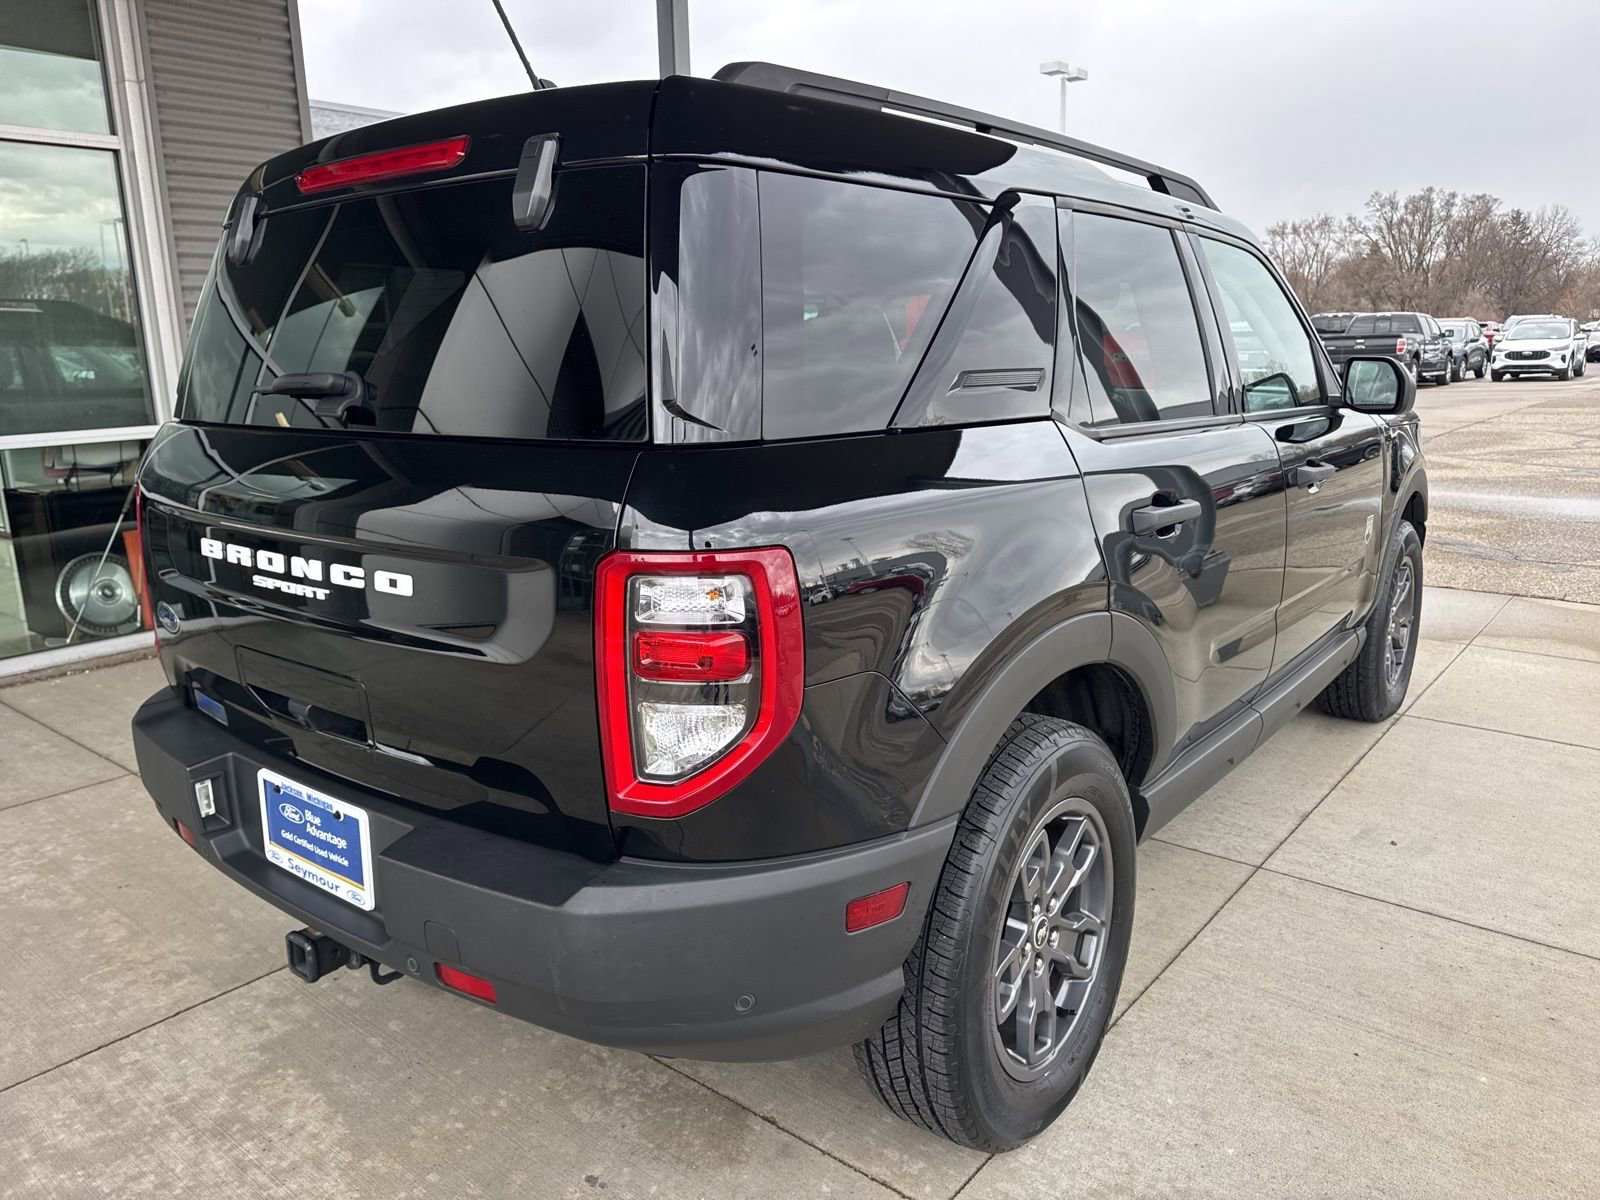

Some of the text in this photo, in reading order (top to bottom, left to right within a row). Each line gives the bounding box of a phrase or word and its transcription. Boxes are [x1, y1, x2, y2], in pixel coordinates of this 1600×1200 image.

[201, 537, 413, 597] BRONCO
[252, 574, 330, 600] SPORT
[282, 804, 302, 821] Ford
[304, 808, 321, 826] Blue
[281, 829, 349, 867] Gold Certified Used Vehicle
[306, 822, 347, 849] Advantage
[287, 858, 340, 892] Seymour
